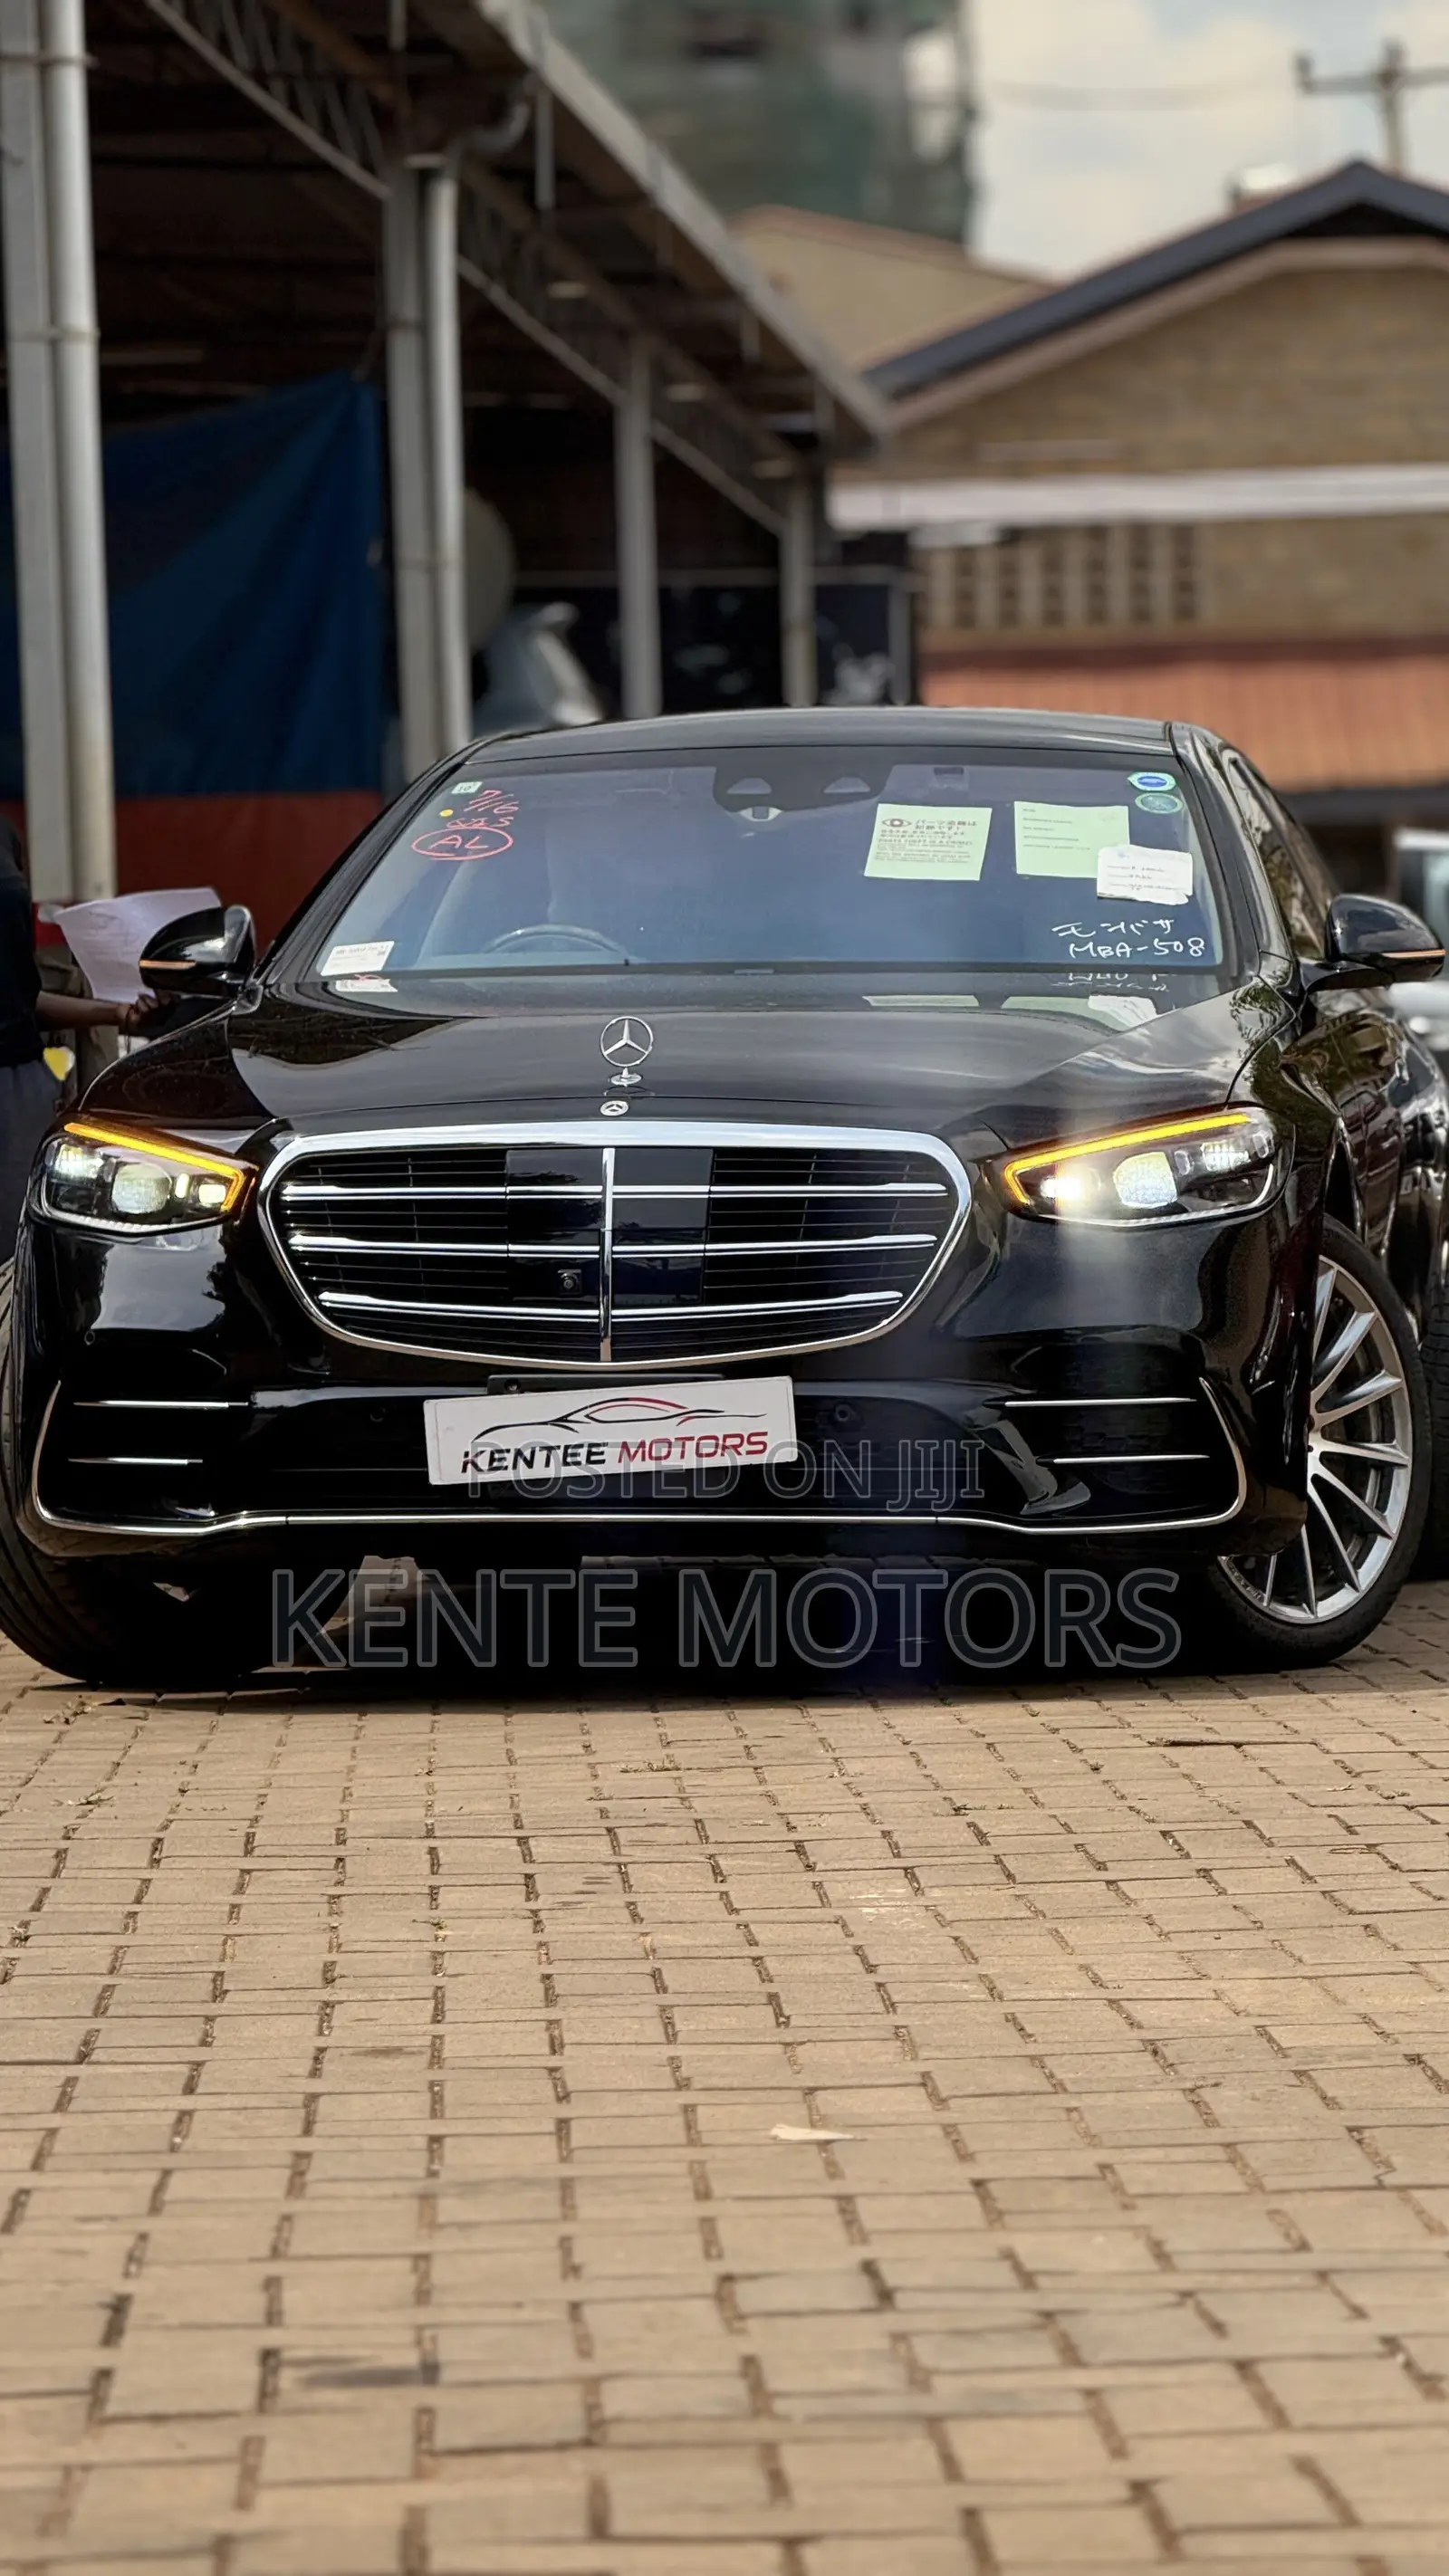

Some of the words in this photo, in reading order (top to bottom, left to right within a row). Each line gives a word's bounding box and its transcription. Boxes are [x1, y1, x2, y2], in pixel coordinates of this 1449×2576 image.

[428, 834, 490, 849] AL
[1069, 936, 1205, 960] MBA-508
[461, 1441, 609, 1474] KENTEE
[618, 1432, 769, 1464] MOTORS
